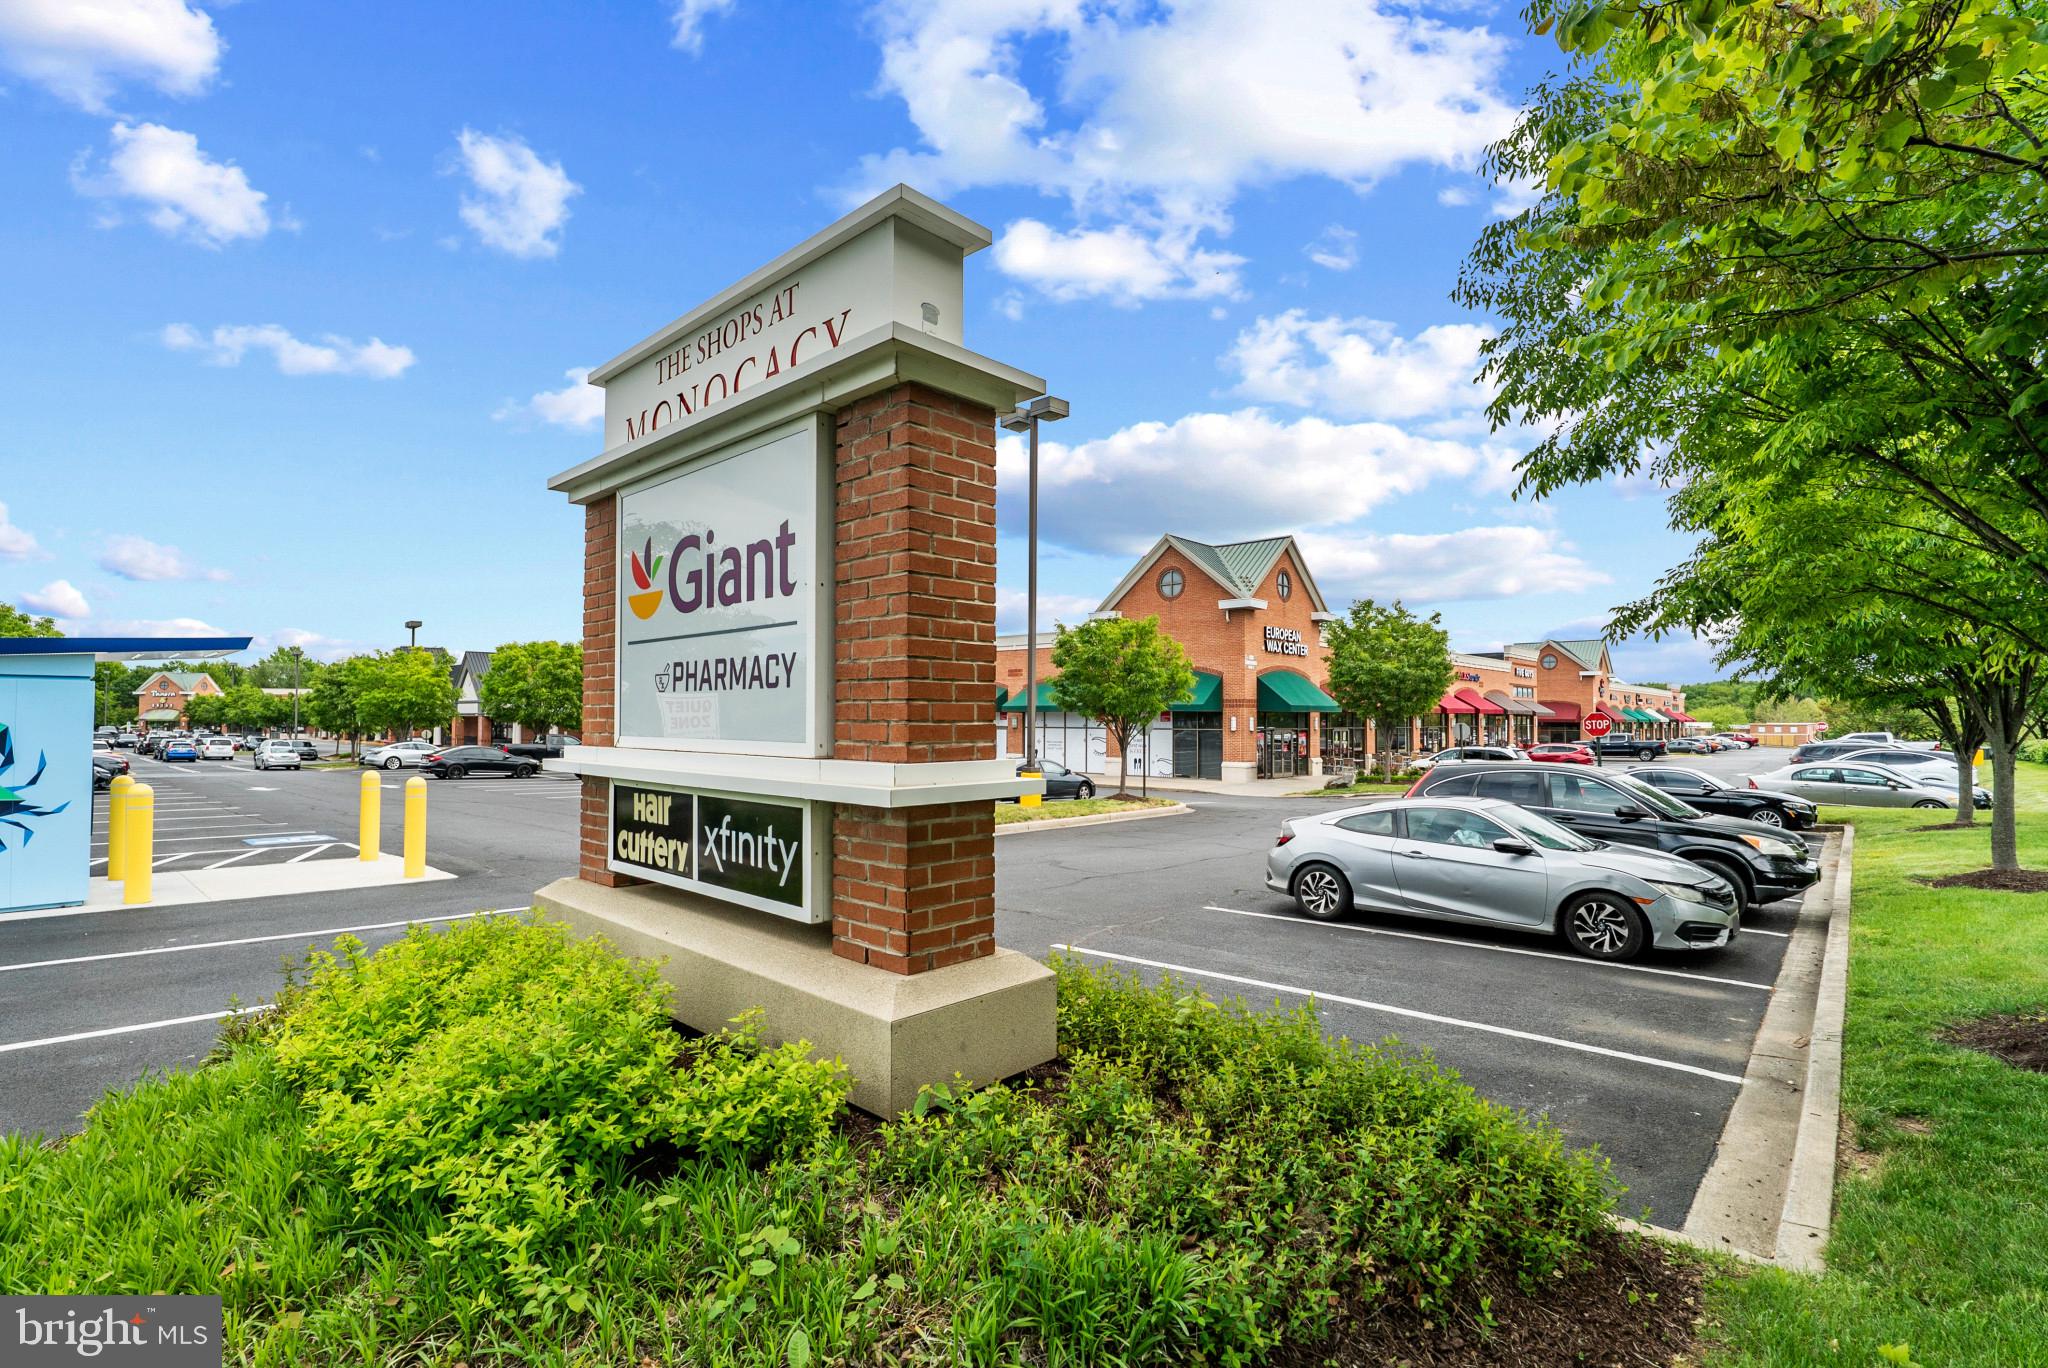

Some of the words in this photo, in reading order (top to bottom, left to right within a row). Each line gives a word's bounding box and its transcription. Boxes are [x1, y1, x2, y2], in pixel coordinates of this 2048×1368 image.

[655, 344, 692, 385] THE
[697, 303, 763, 364] SHOPS
[768, 281, 800, 328] AT
[668, 519, 798, 613] Giant
[1264, 626, 1302, 642] EUROPEAN
[1265, 639, 1283, 653] WAX
[1283, 642, 1309, 656] CENTER
[672, 652, 797, 692] PHARMACY
[1585, 720, 1610, 730] STOP
[633, 792, 672, 826] Hair
[617, 830, 689, 873] cuttery
[704, 814, 799, 887] xfinity
